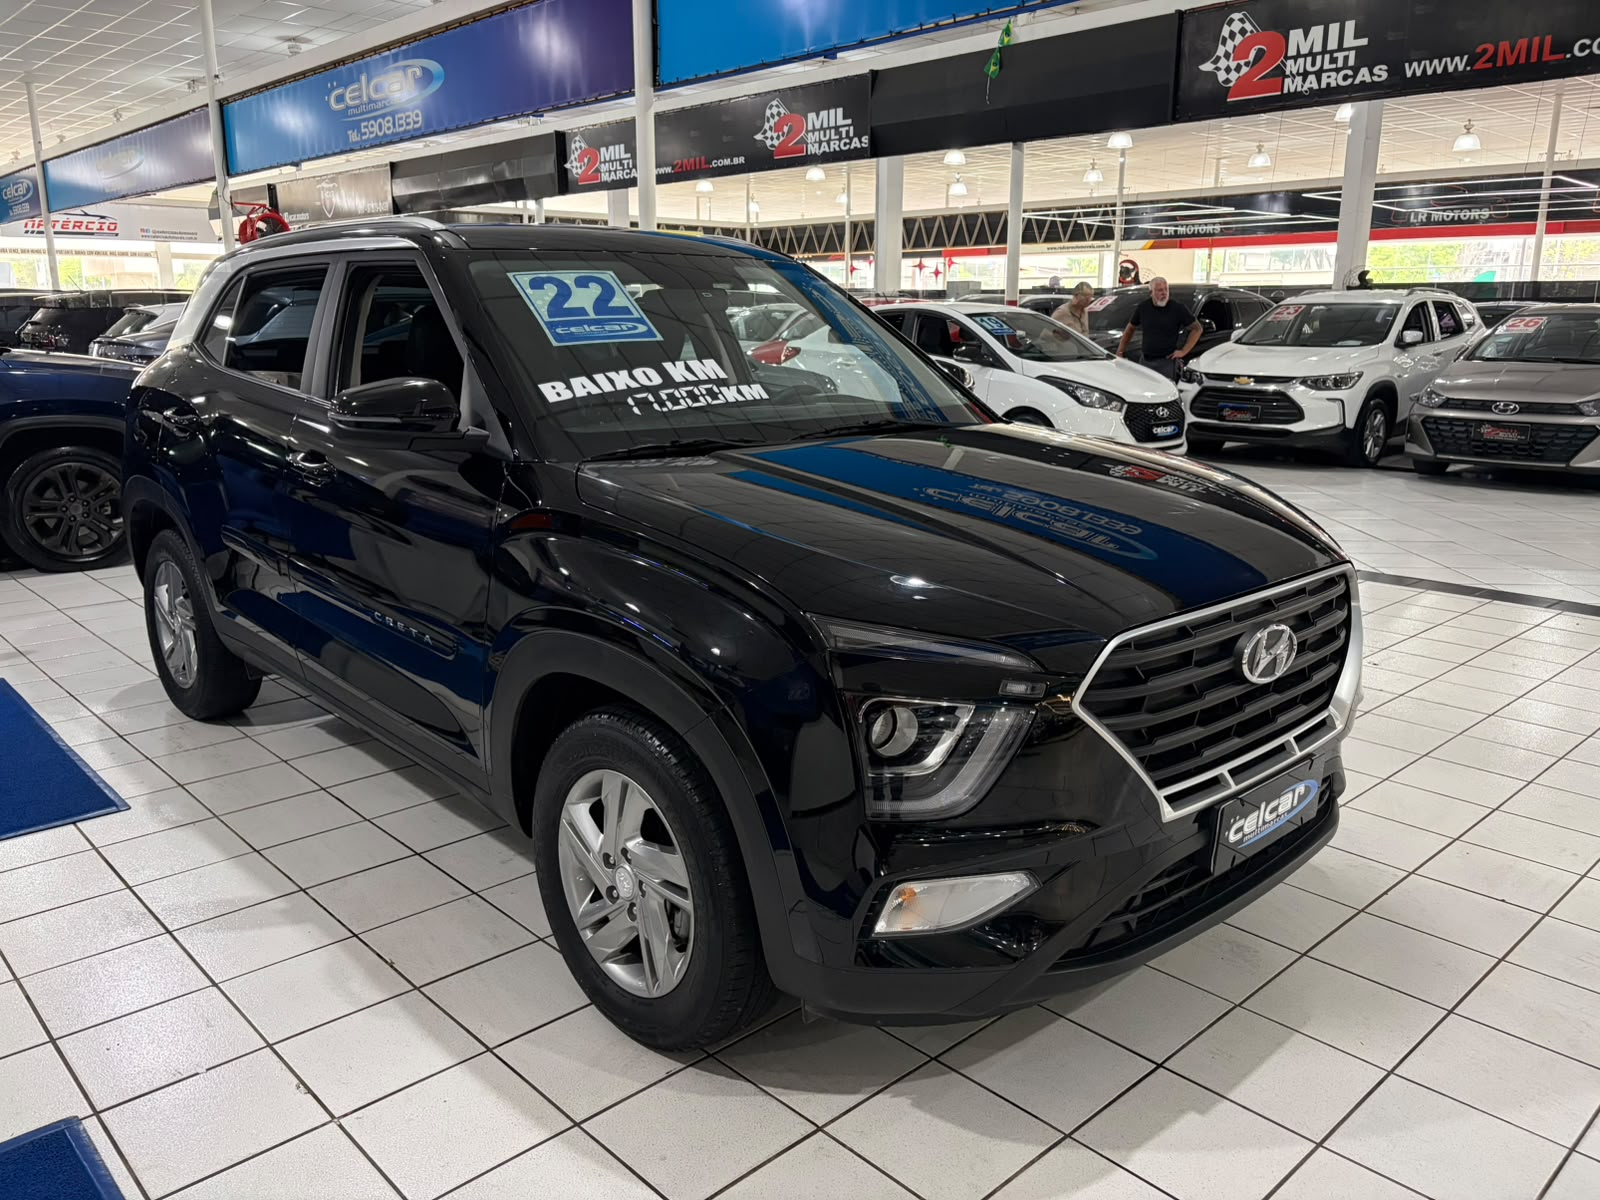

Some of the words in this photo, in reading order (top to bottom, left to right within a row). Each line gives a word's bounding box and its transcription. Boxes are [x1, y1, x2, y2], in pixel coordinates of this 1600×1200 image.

[1227, 31, 1286, 101] 2
[1287, 20, 1369, 56] MIL
[1285, 50, 1356, 75] MULTI
[329, 65, 423, 111] celcar
[1283, 64, 1389, 94] MARCAS
[361, 109, 423, 140] 5908.1339
[773, 113, 806, 159] 2
[807, 107, 852, 129] MIL
[807, 125, 854, 142] MULTI
[807, 135, 869, 155] MARCAS
[578, 147, 600, 185] 2
[600, 143, 632, 161] MIL
[600, 159, 633, 172] MULTI
[600, 168, 638, 183] MARCA
[655, 155, 746, 176] ww.2MIL.COM.BR
[1177, 223, 1221, 236] MOTORS
[1409, 209, 1427, 223] LR
[1430, 208, 1491, 222] MOTORS
[528, 274, 635, 318] 22
[556, 324, 635, 333] celcar
[537, 367, 663, 403] BAIXO
[662, 359, 728, 383] KM
[374, 611, 433, 646] CRETA
[1228, 783, 1306, 843] celcar
